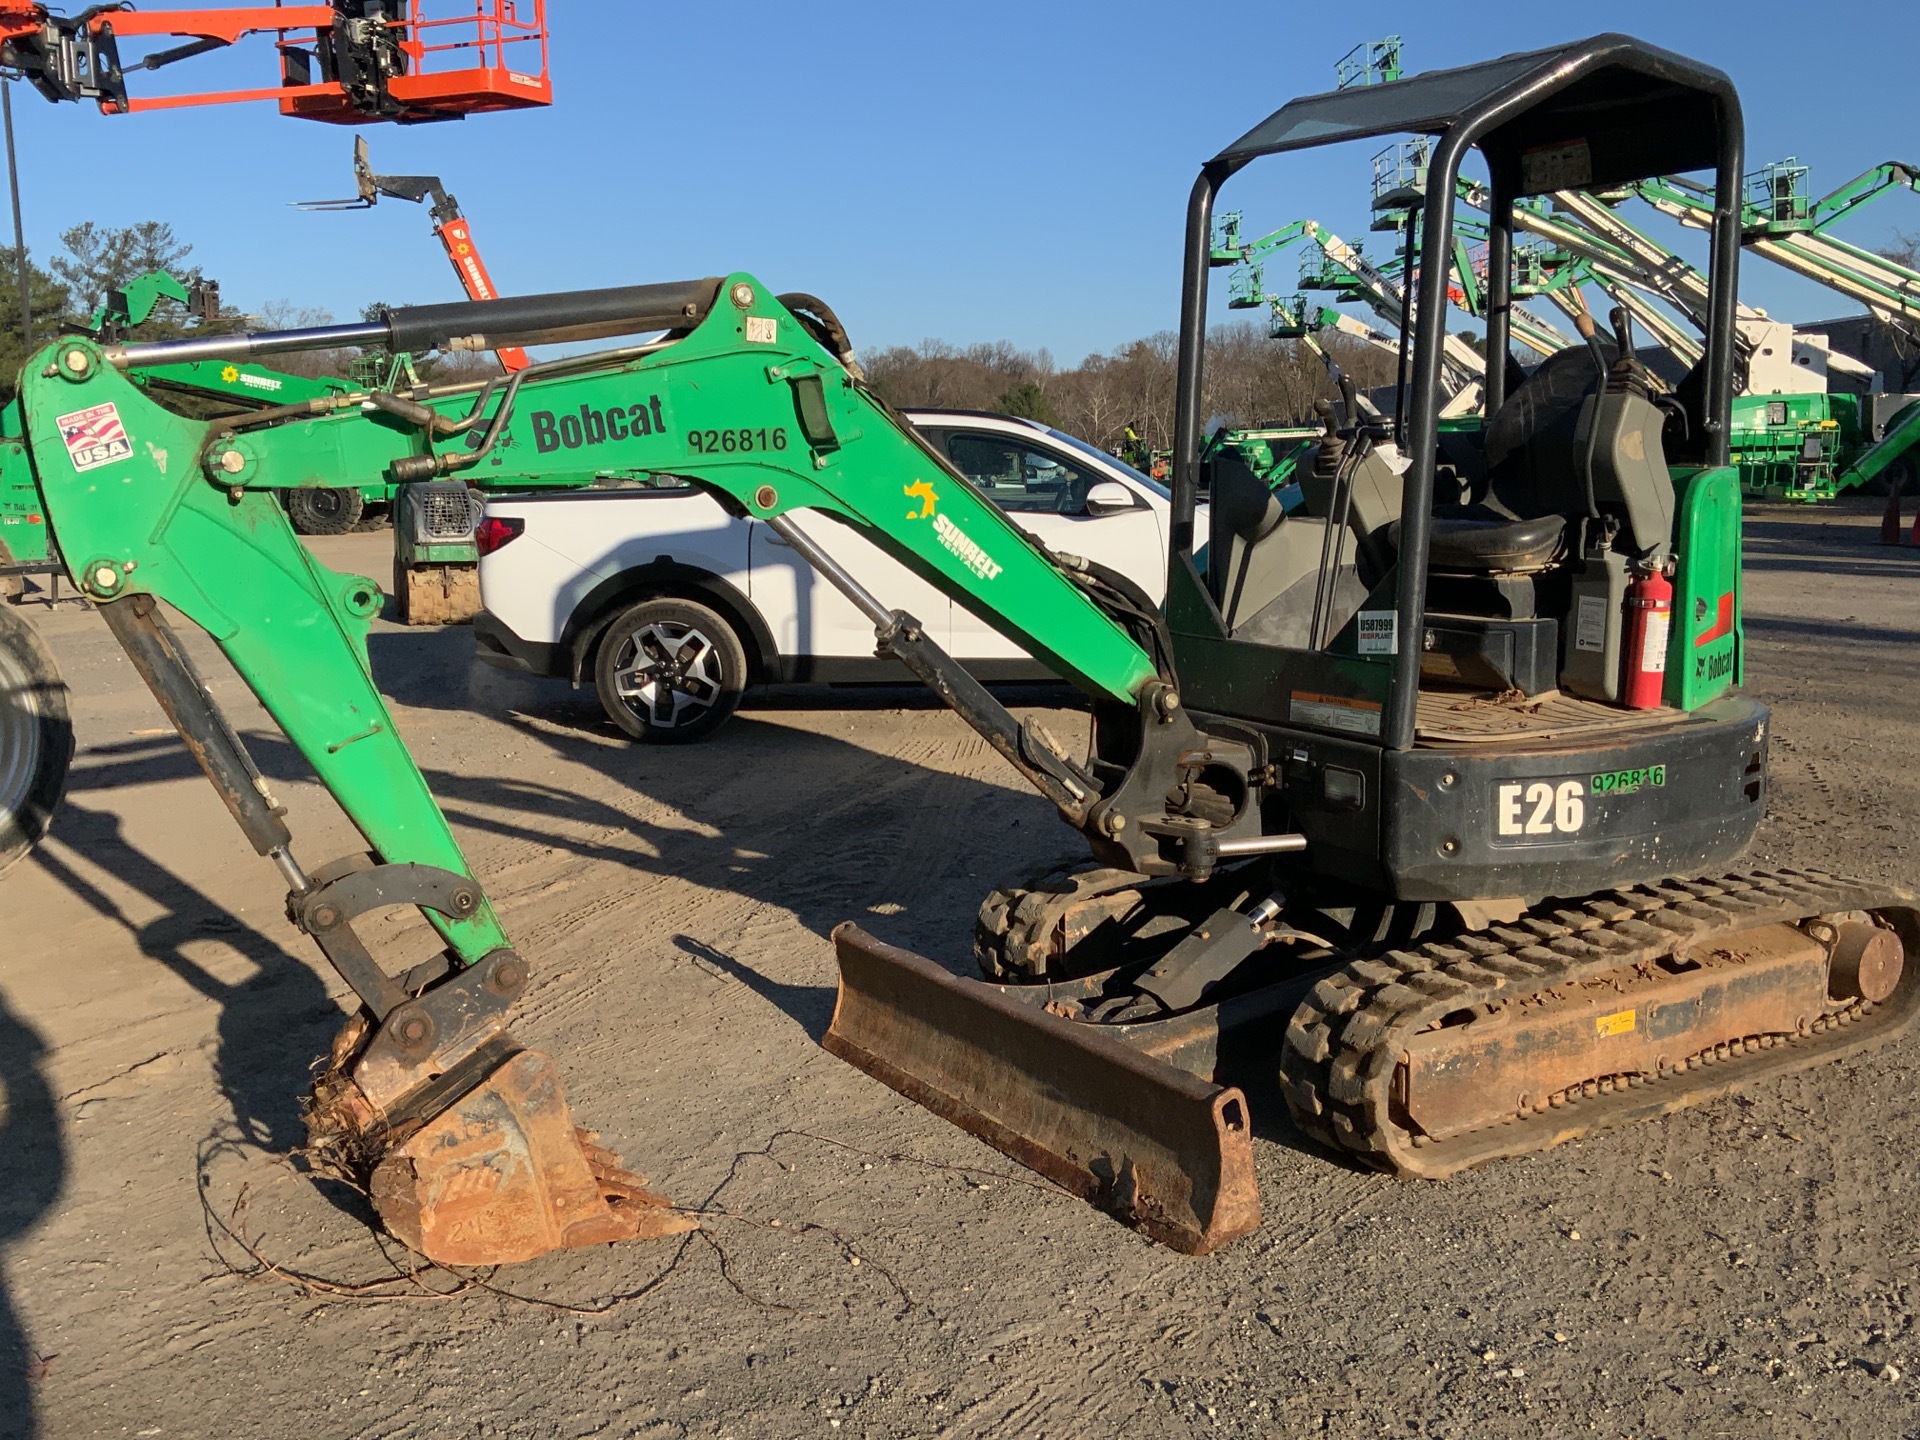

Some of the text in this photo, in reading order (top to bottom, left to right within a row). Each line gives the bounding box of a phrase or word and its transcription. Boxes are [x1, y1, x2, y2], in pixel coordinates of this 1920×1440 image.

[1510, 303, 1536, 323] ENTALS
[240, 373, 282, 390] SUNBELT
[60, 406, 111, 426] MADE IN THE
[530, 394, 667, 455] Bobcat
[74, 441, 128, 465] USA
[687, 427, 788, 454] 926816
[932, 513, 1004, 581] SUNBELT
[936, 534, 986, 580] RENTALS
[1360, 618, 1394, 631] U587999
[1708, 646, 1733, 682] Bobcat
[1498, 781, 1585, 836] E26
